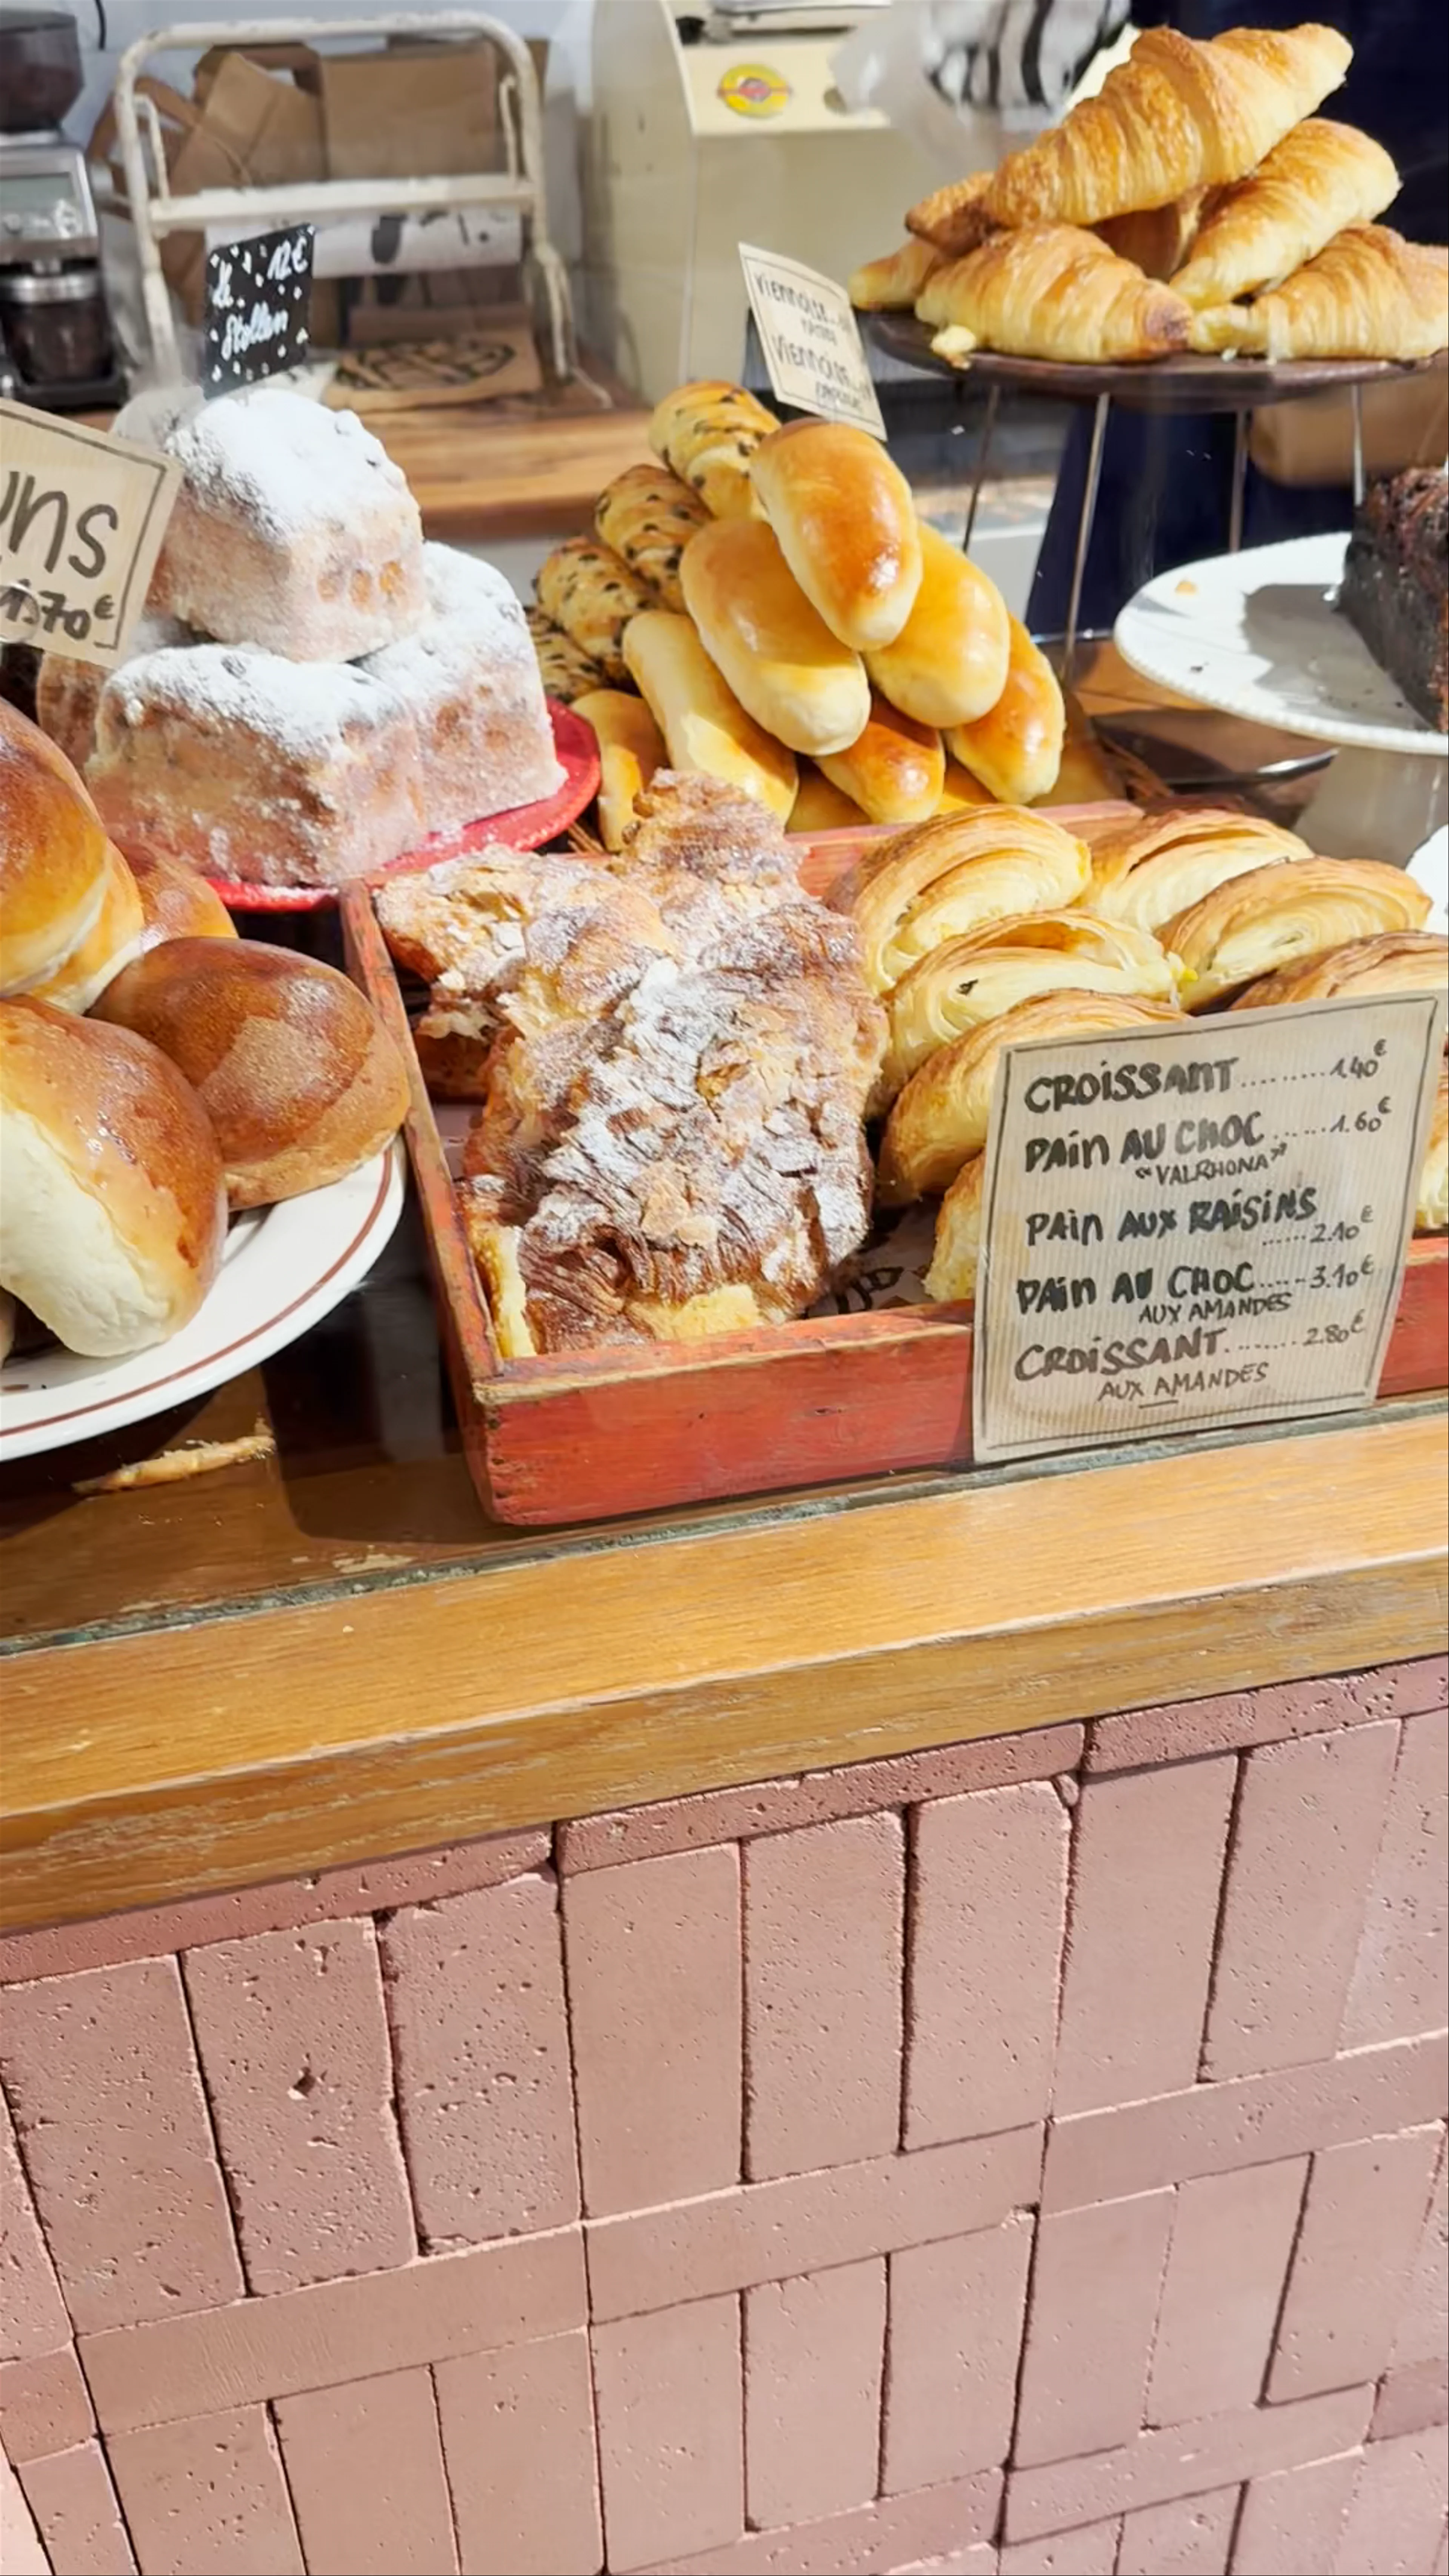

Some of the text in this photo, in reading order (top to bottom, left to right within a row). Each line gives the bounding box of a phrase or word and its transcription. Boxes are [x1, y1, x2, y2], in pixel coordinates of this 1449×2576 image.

[1024, 1057, 1239, 1113] CROISSANT
[1120, 1123, 1166, 1164] AU
[1175, 1111, 1264, 1154] CHOC
[1118, 1209, 1177, 1241] AUX
[1189, 1187, 1317, 1234] RAISINS
[1112, 1268, 1153, 1303] AU
[1168, 1262, 1255, 1298] CHOC
[1139, 1292, 1292, 1324] AUX AMANDES
[1015, 1326, 1227, 1381] CROISSANT
[1098, 1362, 1269, 1401] AUX AMANDES
